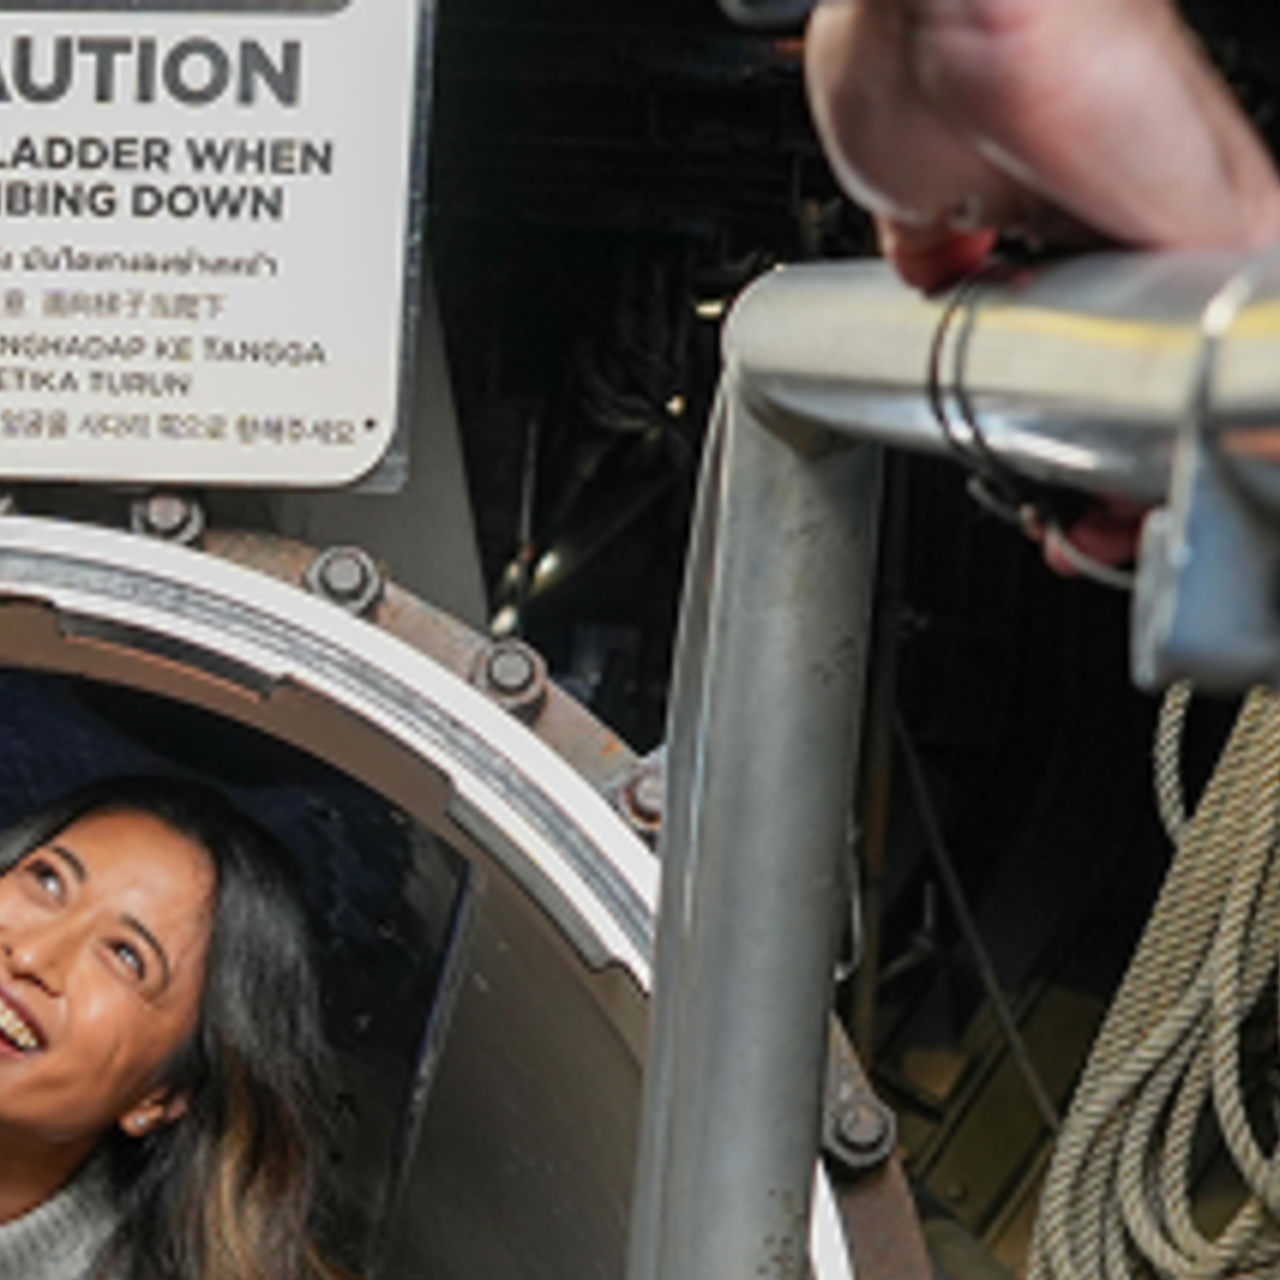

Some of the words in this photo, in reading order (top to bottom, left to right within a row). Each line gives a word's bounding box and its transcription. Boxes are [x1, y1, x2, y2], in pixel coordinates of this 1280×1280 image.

[185, 138, 333, 176] WHEN
[131, 184, 284, 220] DOWN
[154, 335, 193, 362] KE
[202, 335, 326, 365] TANGGA
[88, 370, 192, 398] TURUN
